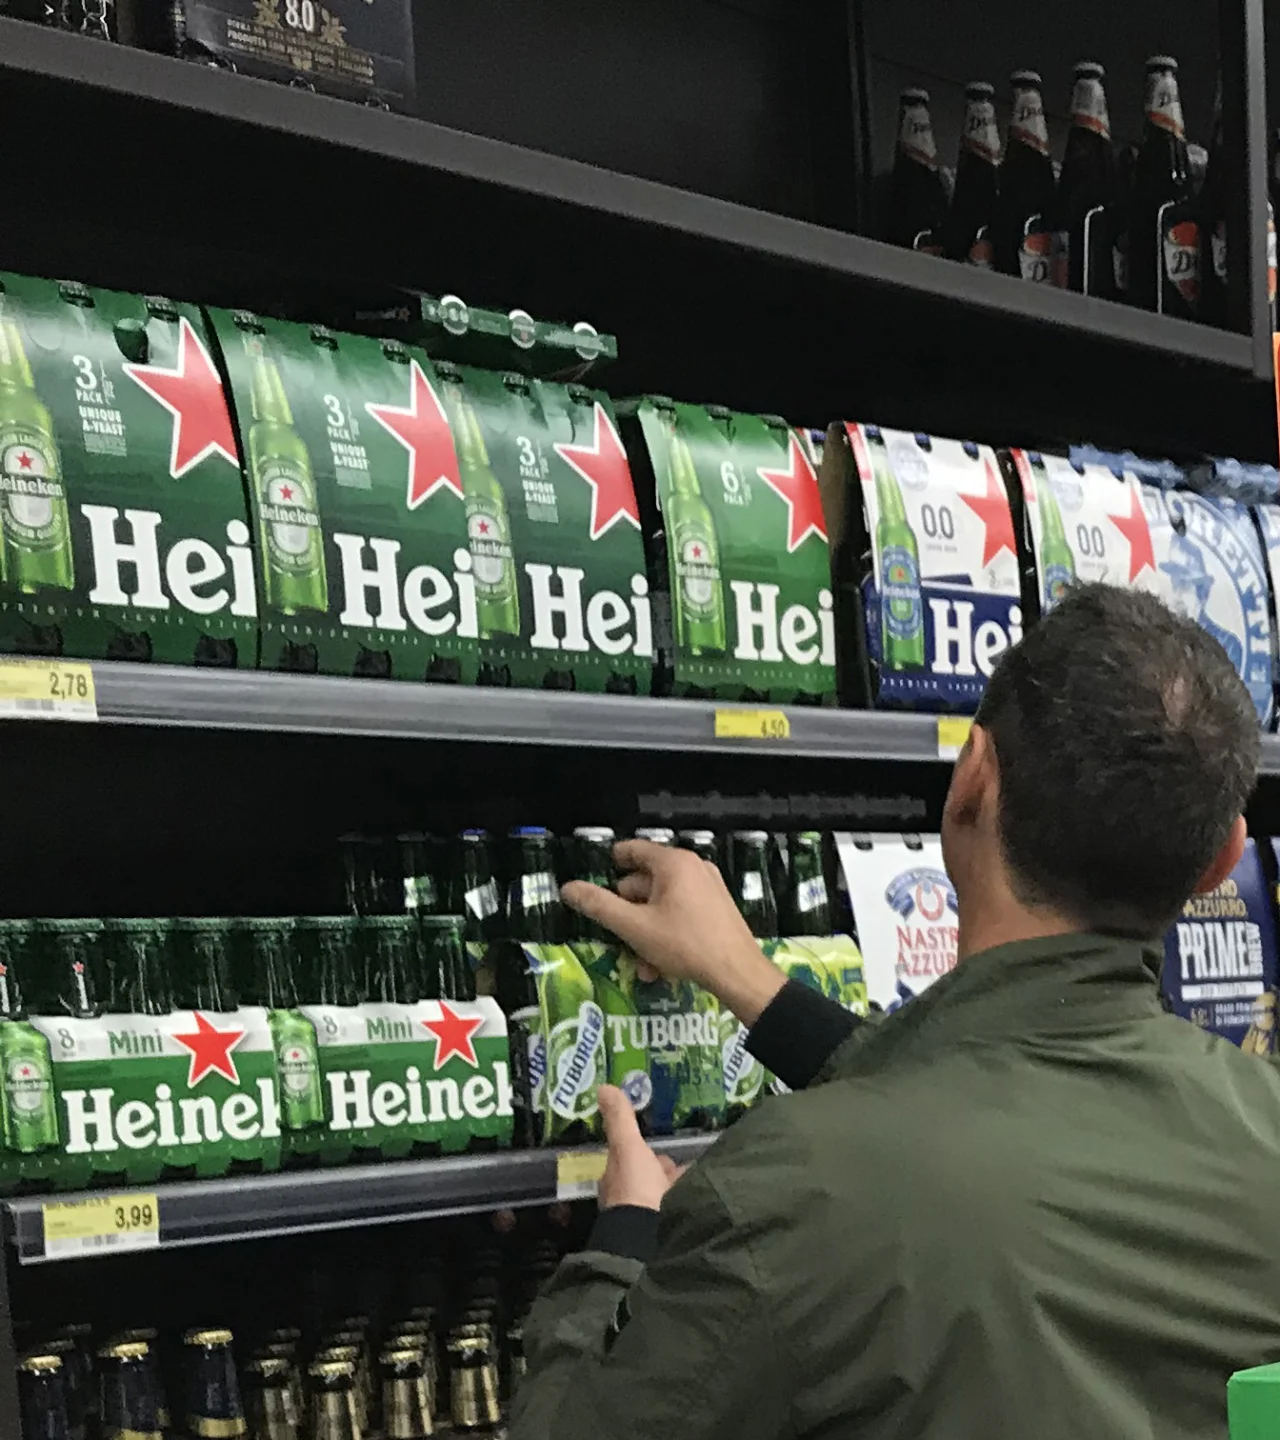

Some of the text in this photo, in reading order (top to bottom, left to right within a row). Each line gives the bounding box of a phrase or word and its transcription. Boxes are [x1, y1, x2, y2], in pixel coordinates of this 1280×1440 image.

[72, 354, 97, 390] 3
[79, 405, 122, 423] UNIQUE
[324, 394, 344, 427] 3
[516, 436, 536, 467] 3
[720, 461, 739, 493] 6
[49, 672, 88, 698] 2,78
[1177, 922, 1250, 980] PRIME
[107, 1029, 164, 1056] Mini
[366, 1015, 413, 1042] Mini
[606, 1010, 719, 1052] TUBORG
[553, 1019, 602, 1110] TUBORG
[114, 1205, 153, 1230] 3,99
